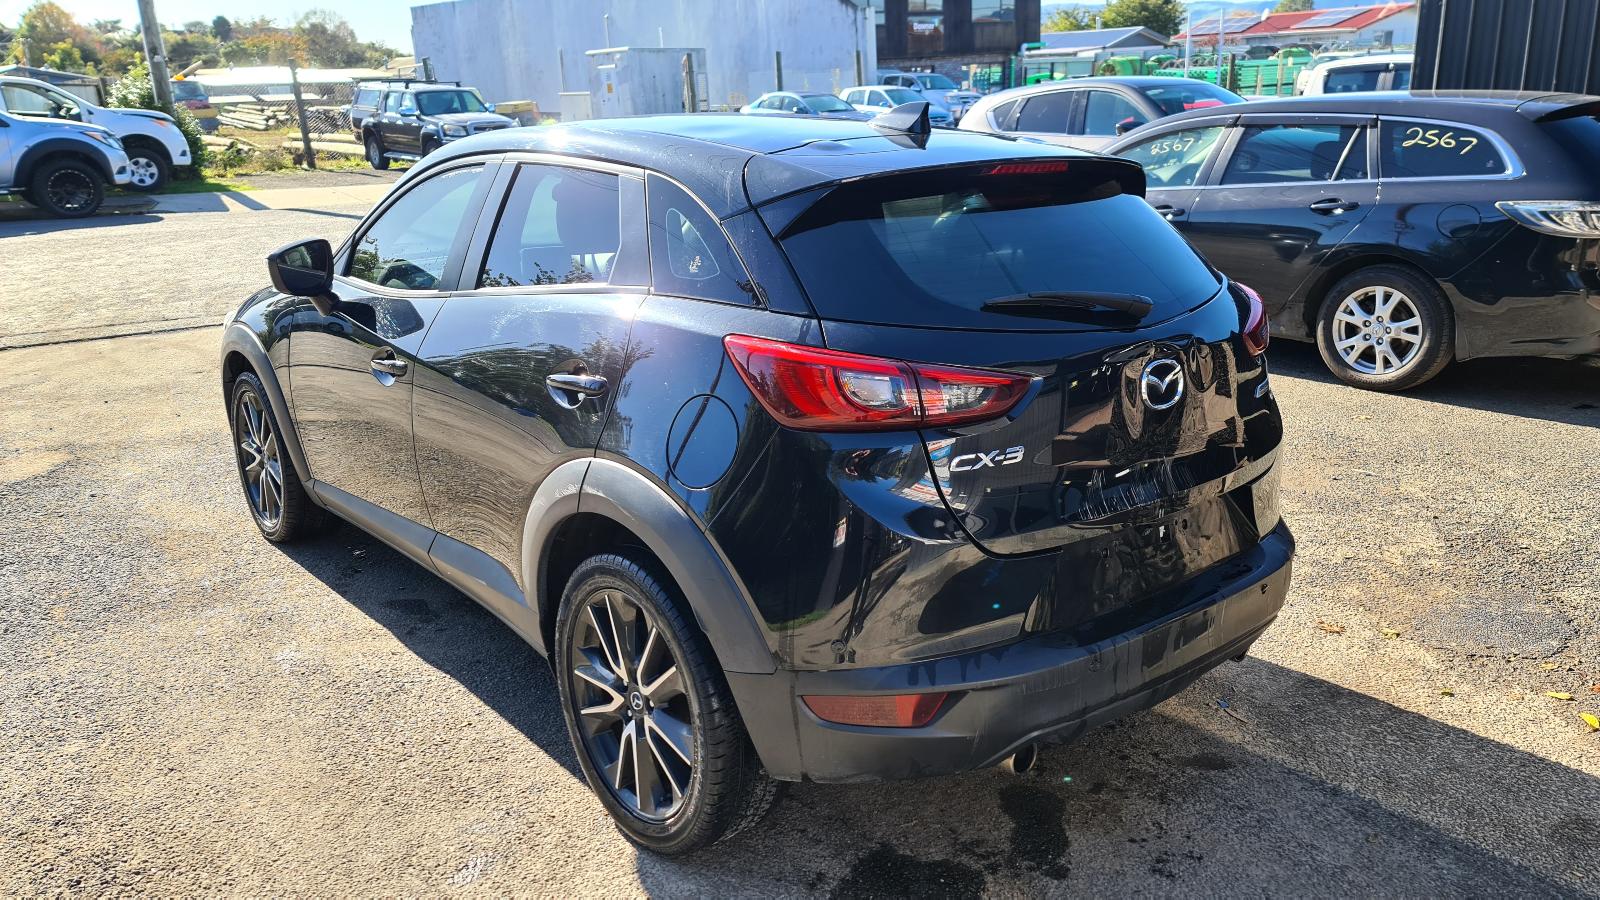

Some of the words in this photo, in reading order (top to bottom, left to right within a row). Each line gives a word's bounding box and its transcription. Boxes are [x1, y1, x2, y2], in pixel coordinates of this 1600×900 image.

[1151, 132, 1194, 155] 2567
[1402, 127, 1478, 155] 2567
[950, 445, 1025, 472] CX-3
